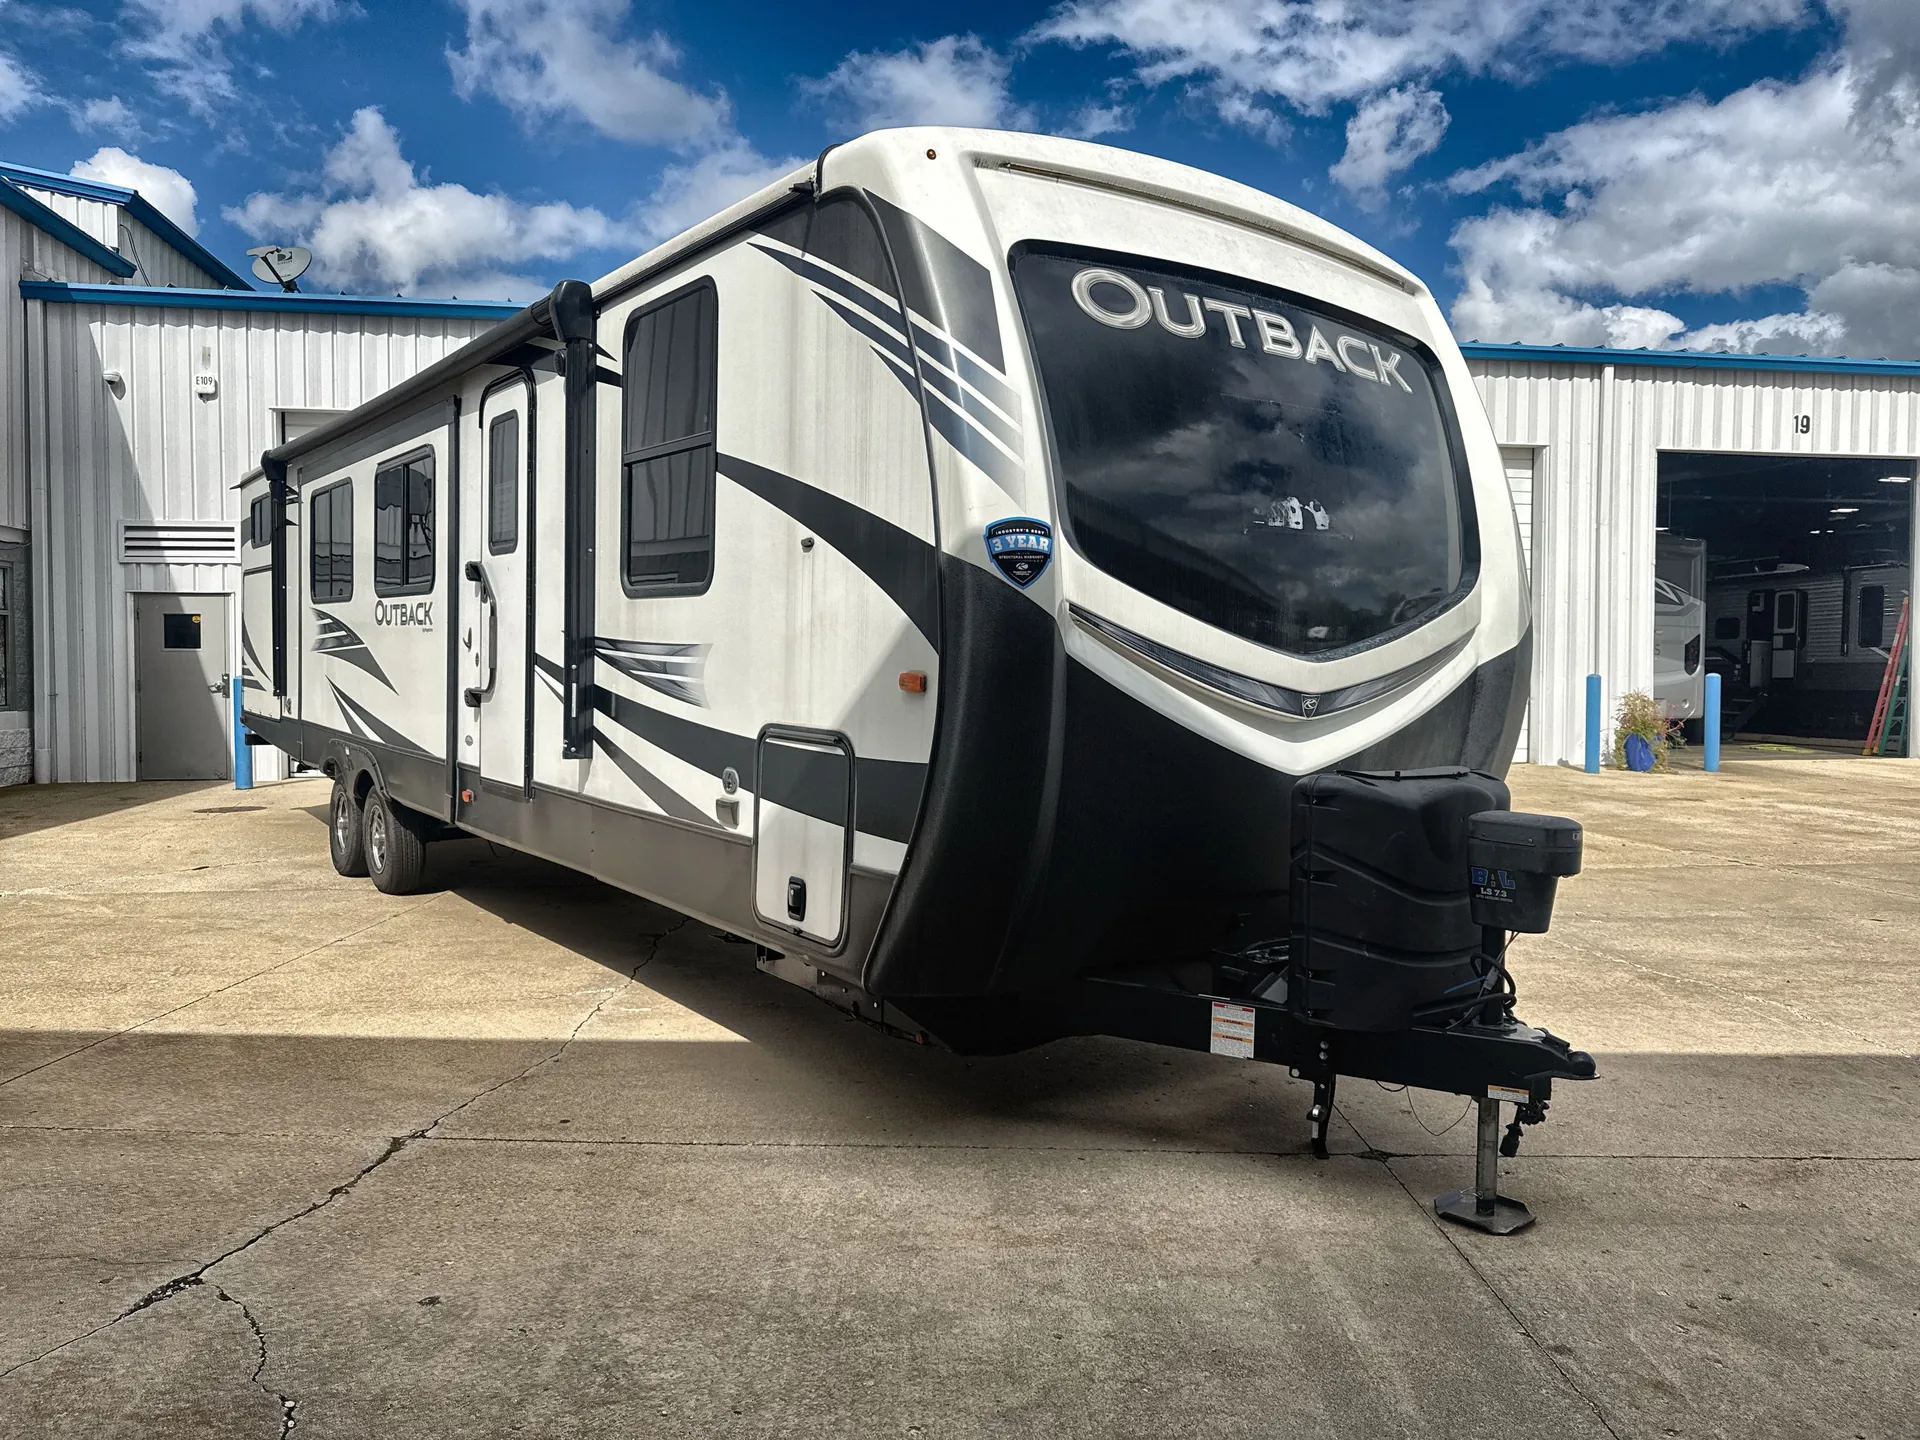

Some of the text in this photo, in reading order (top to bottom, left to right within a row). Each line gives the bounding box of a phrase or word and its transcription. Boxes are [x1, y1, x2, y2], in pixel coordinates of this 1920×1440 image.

[1071, 267, 1413, 394] OUTBACK
[195, 376, 213, 386] E109
[1794, 415, 1811, 434] 19
[992, 535, 1049, 552] 3 YEAR
[375, 599, 433, 626] OUTBACK
[1480, 887, 1493, 896] LS
